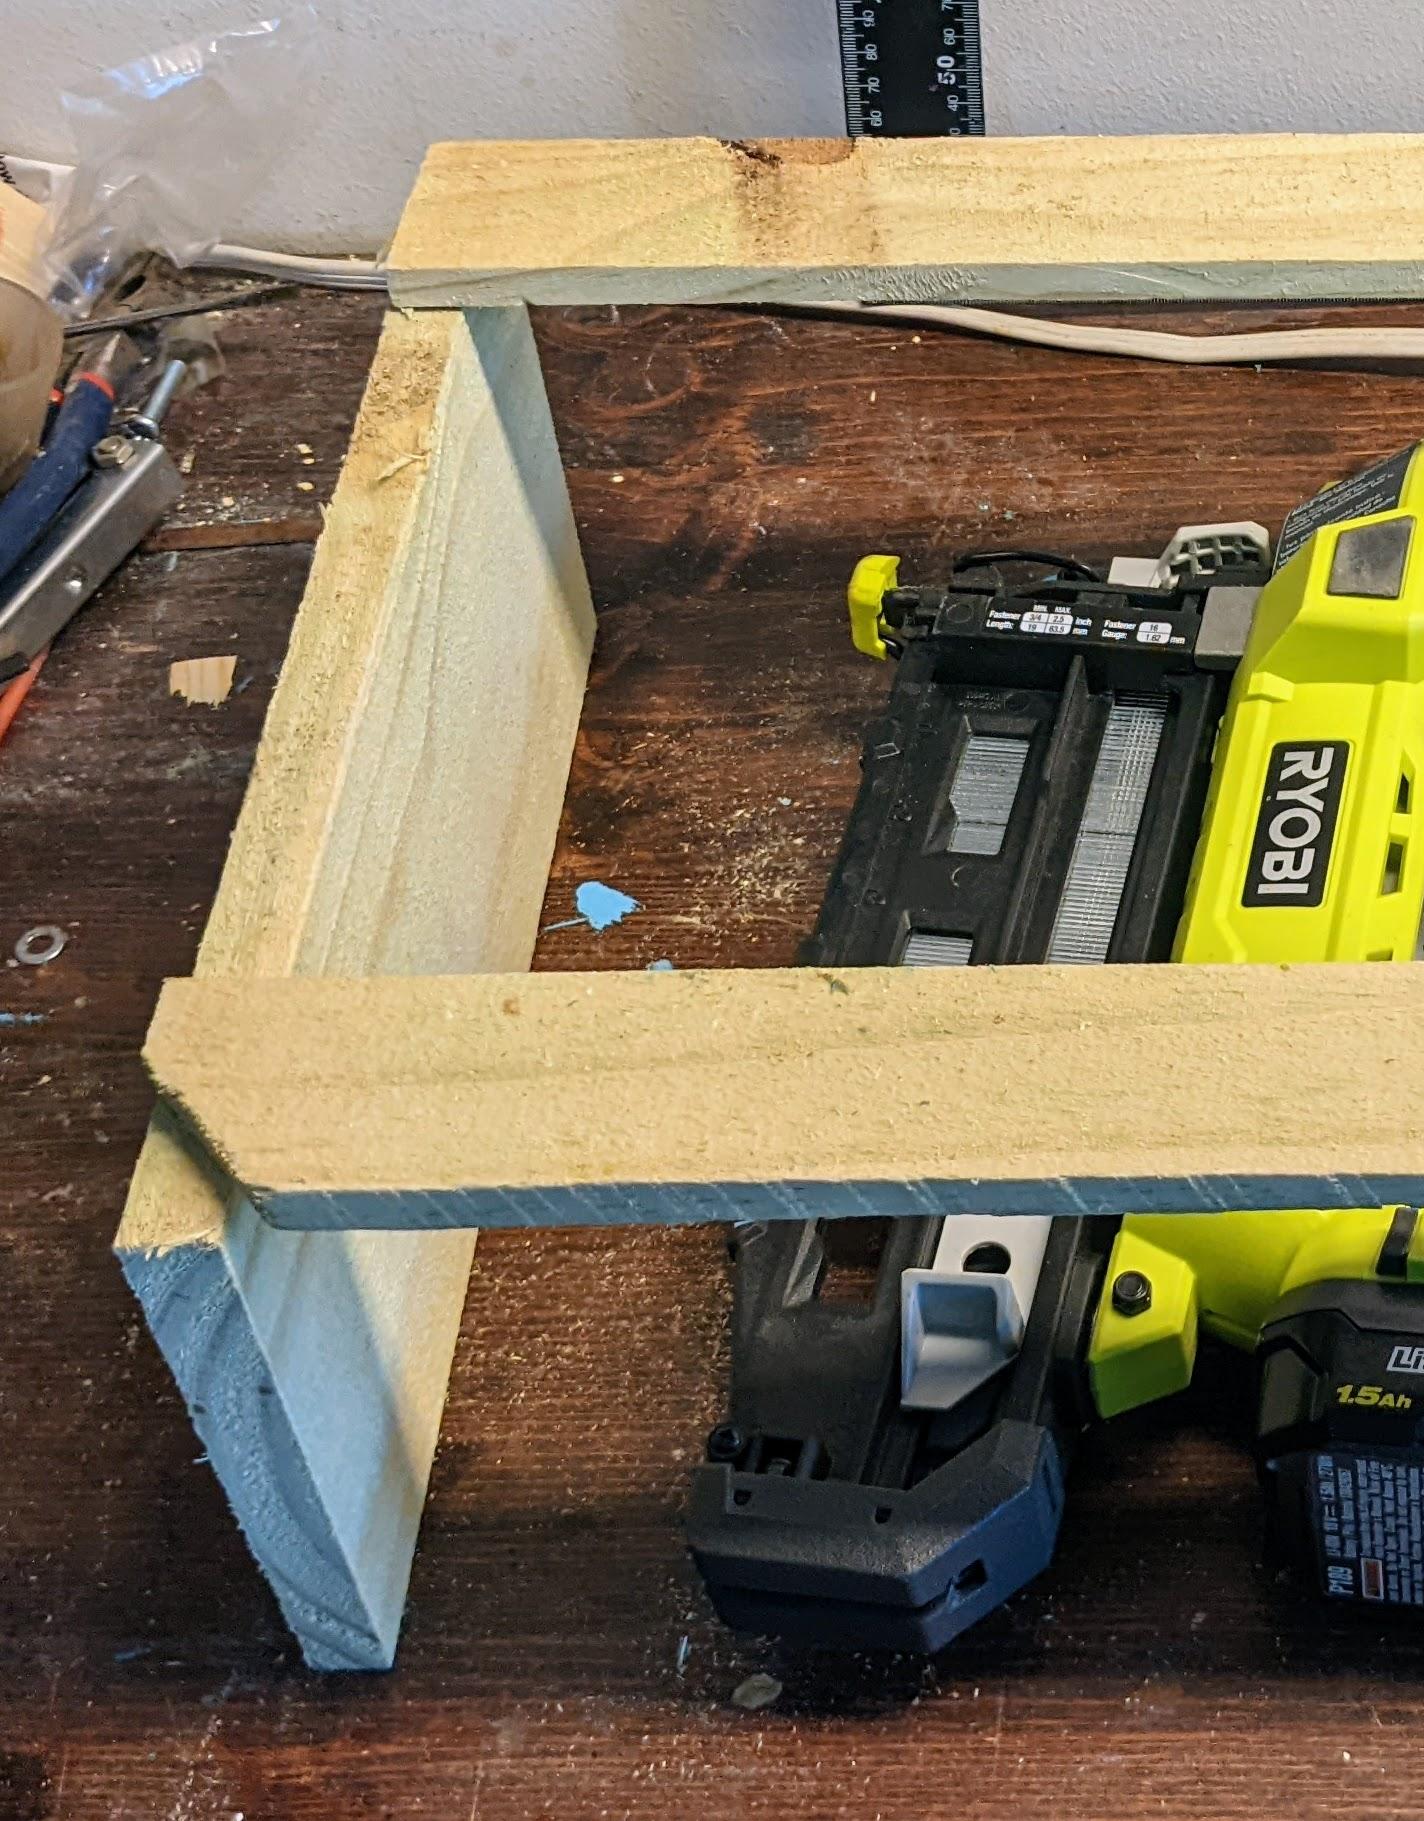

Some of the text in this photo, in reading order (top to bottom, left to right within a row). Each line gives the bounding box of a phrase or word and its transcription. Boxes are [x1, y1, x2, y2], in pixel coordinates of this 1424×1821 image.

[862, 10, 875, 27] 90
[943, 28, 956, 46] 60
[865, 44, 878, 61] 80
[936, 55, 956, 85] 50
[868, 77, 881, 94] 70
[946, 95, 959, 112] 40
[1257, 747, 1335, 895] RYOBI
[1336, 1384, 1412, 1409] 1.5Ah
